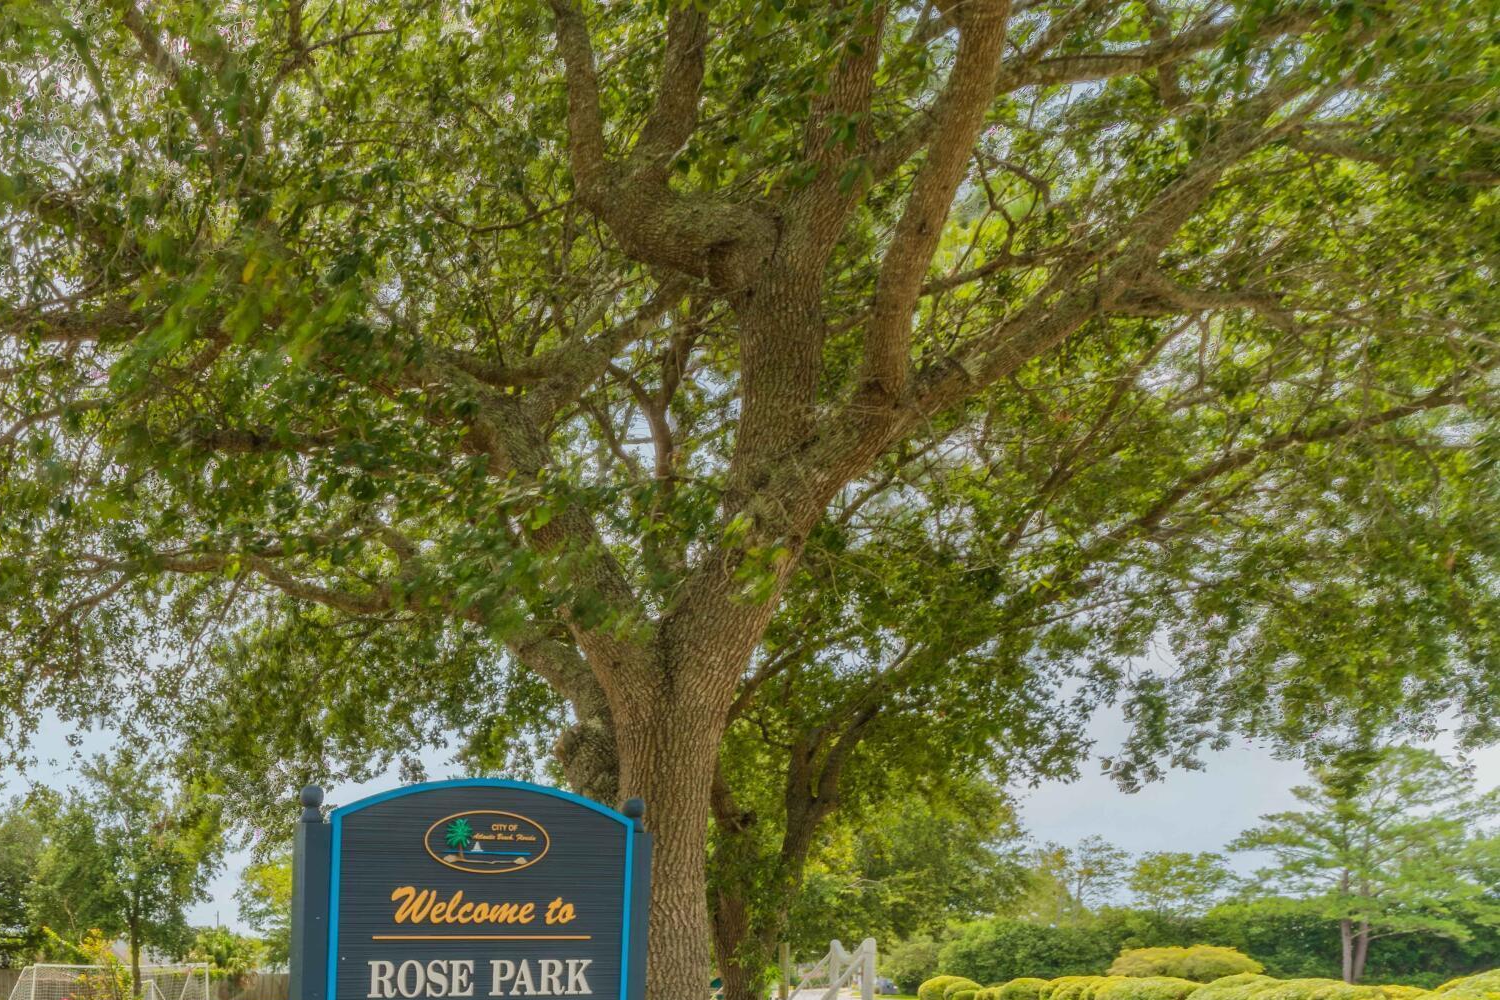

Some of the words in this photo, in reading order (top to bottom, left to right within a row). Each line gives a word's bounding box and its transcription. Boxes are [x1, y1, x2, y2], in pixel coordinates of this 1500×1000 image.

[508, 824, 518, 832] OF
[391, 886, 535, 924] Welcome
[545, 897, 577, 925] to
[367, 959, 475, 998] ROSE
[488, 958, 593, 997] PARK
